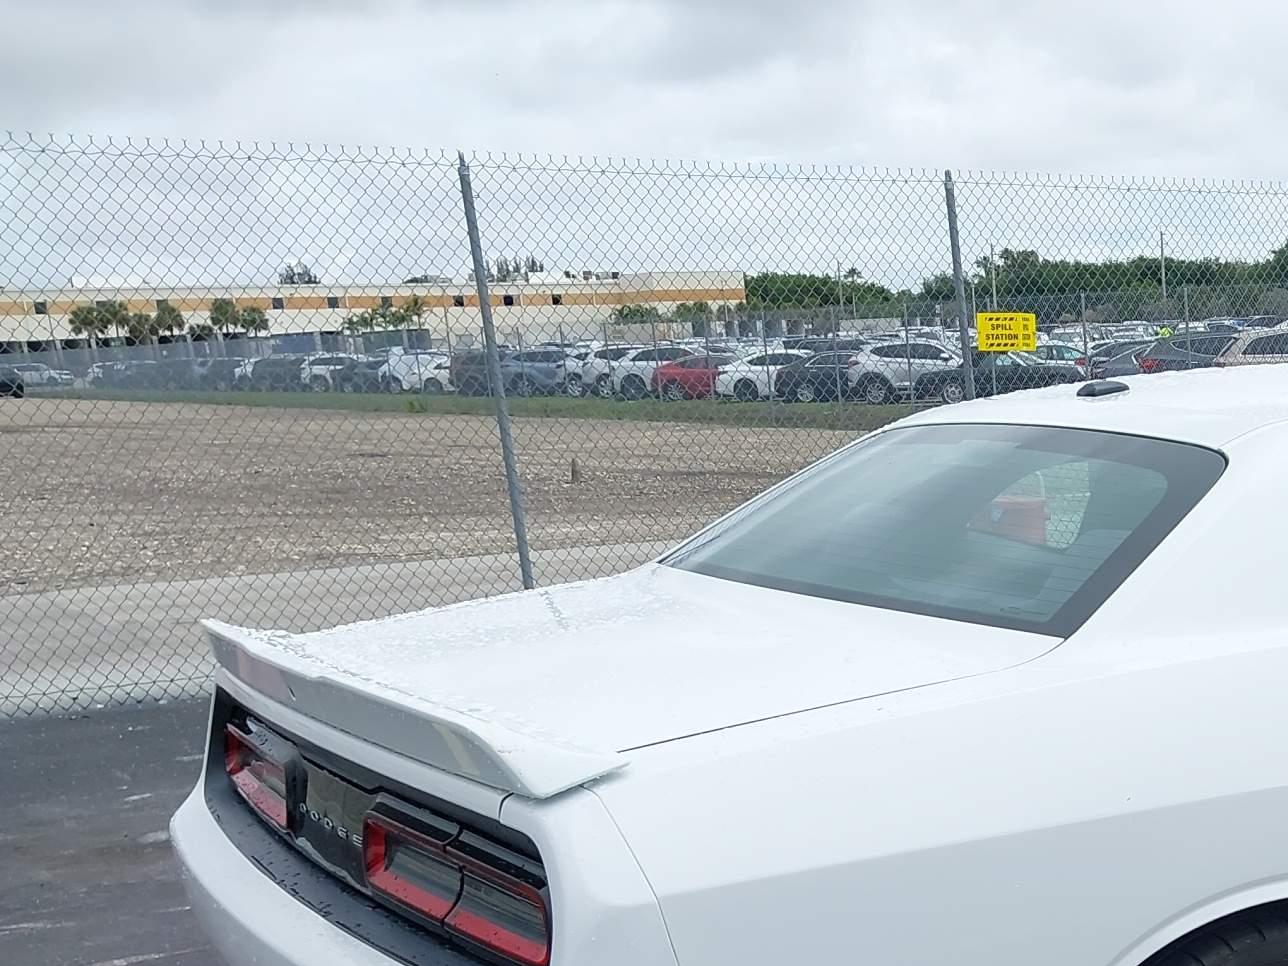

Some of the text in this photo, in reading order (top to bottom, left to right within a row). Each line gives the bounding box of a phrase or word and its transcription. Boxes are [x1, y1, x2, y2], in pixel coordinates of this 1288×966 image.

[990, 323, 1013, 331] SPILL
[985, 333, 1019, 341] STATION
[299, 802, 363, 848] DODGE
